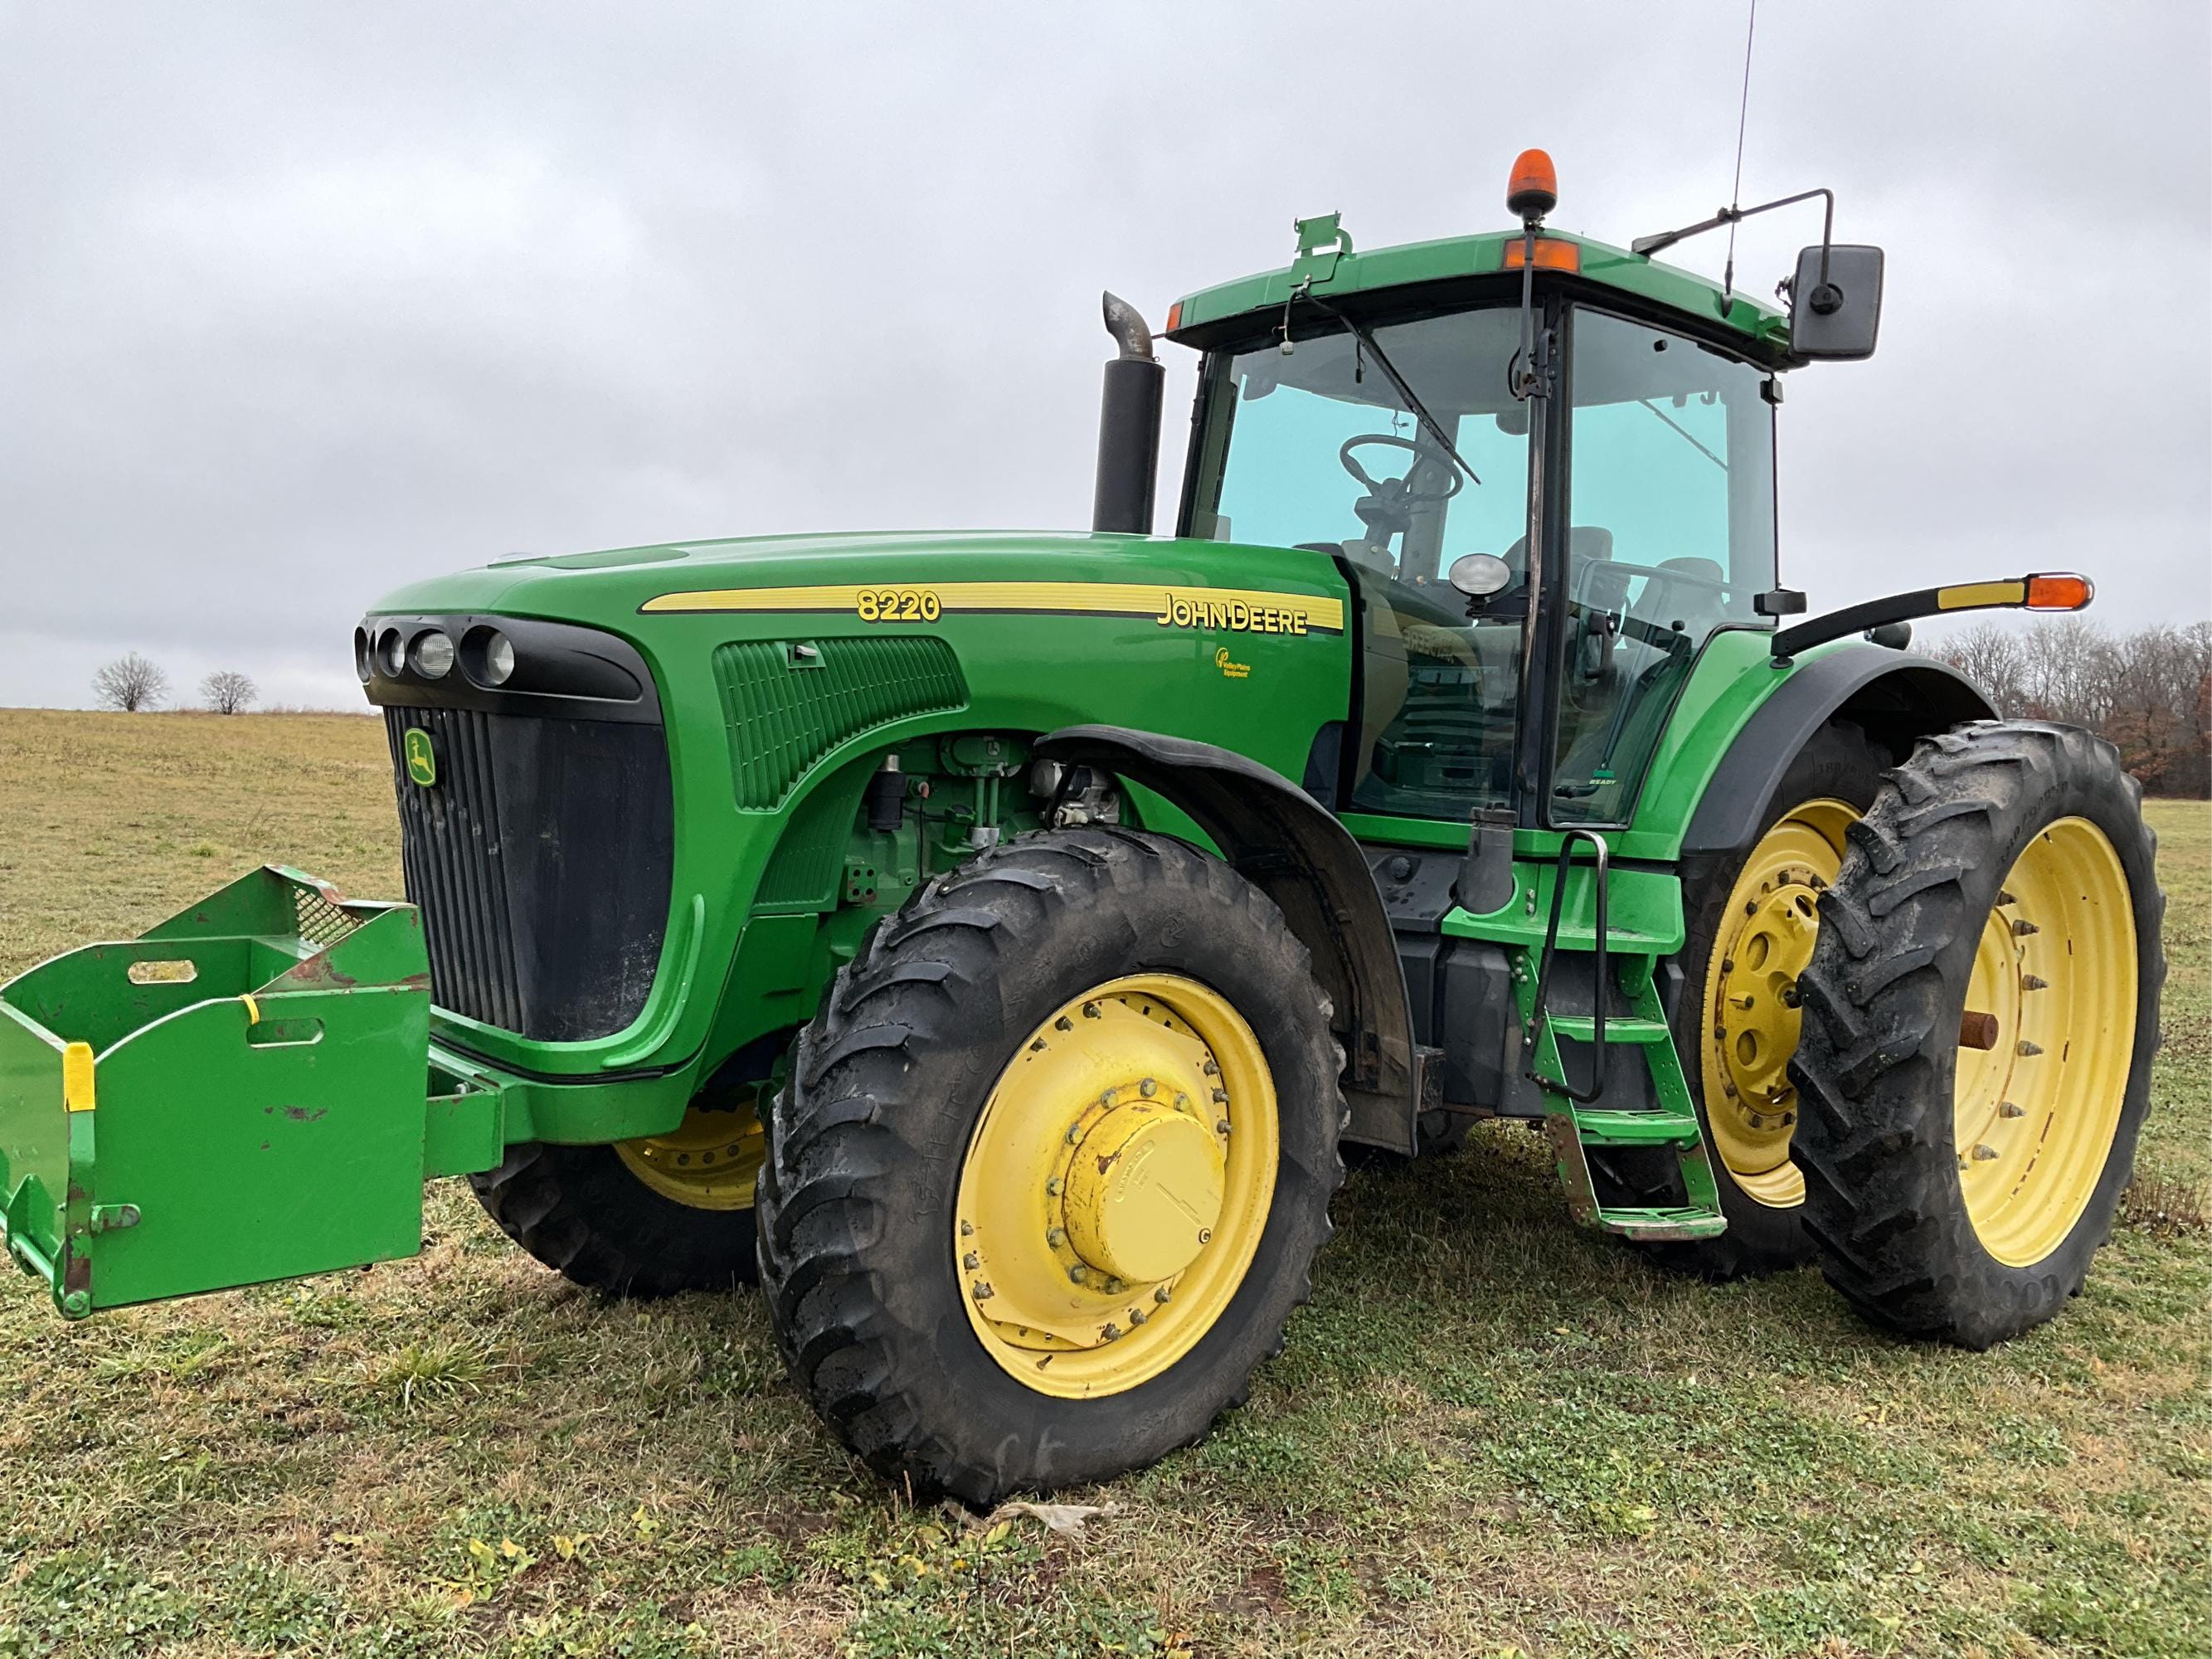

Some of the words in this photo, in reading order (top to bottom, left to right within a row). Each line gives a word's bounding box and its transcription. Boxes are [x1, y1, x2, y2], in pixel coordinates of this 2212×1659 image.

[857, 589, 941, 624] 8220
[1157, 593, 1227, 629] JOHN
[1230, 599, 1307, 635] DEERE
